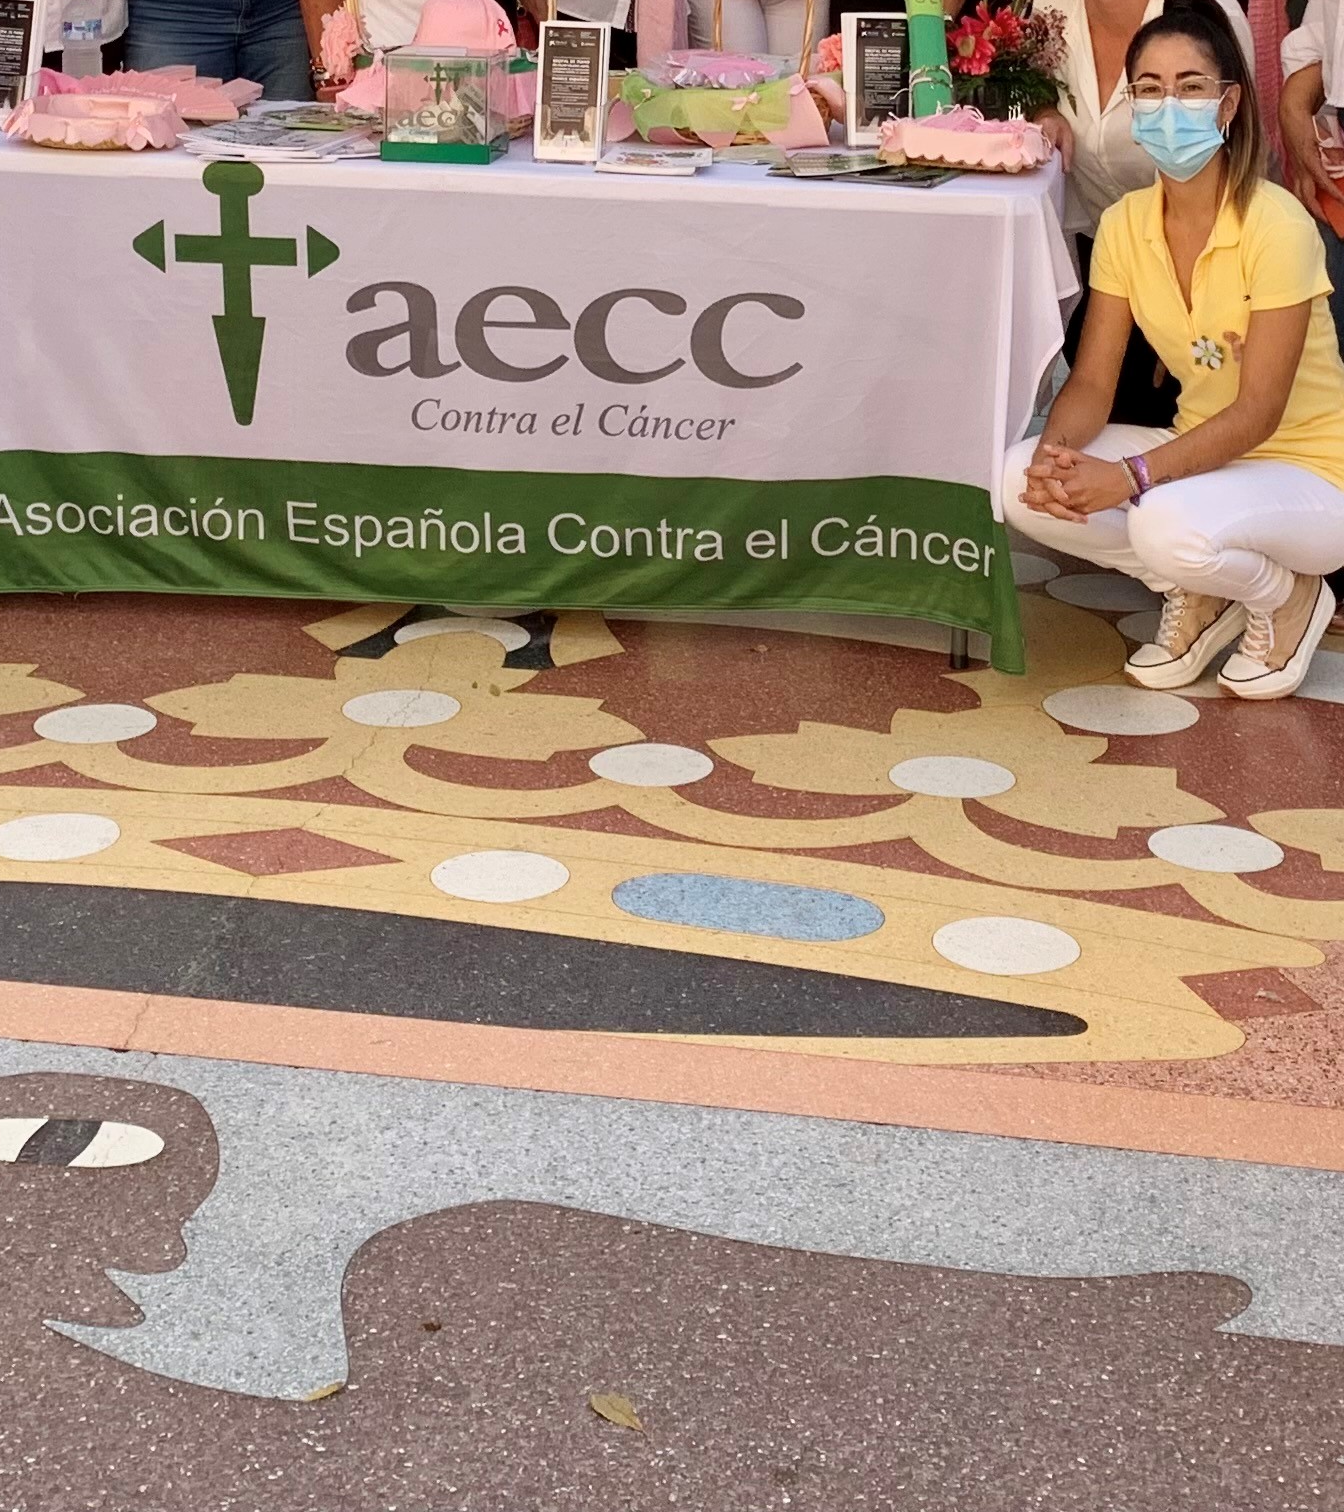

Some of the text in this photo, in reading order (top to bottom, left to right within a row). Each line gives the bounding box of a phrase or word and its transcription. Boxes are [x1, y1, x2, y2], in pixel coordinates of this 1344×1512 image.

[345, 280, 806, 391] aecc
[411, 398, 736, 441] Contra el Cáncer
[286, 500, 526, 558] Española
[547, 512, 724, 562] Contra
[746, 518, 789, 561] el
[811, 514, 996, 578] Cáncer
